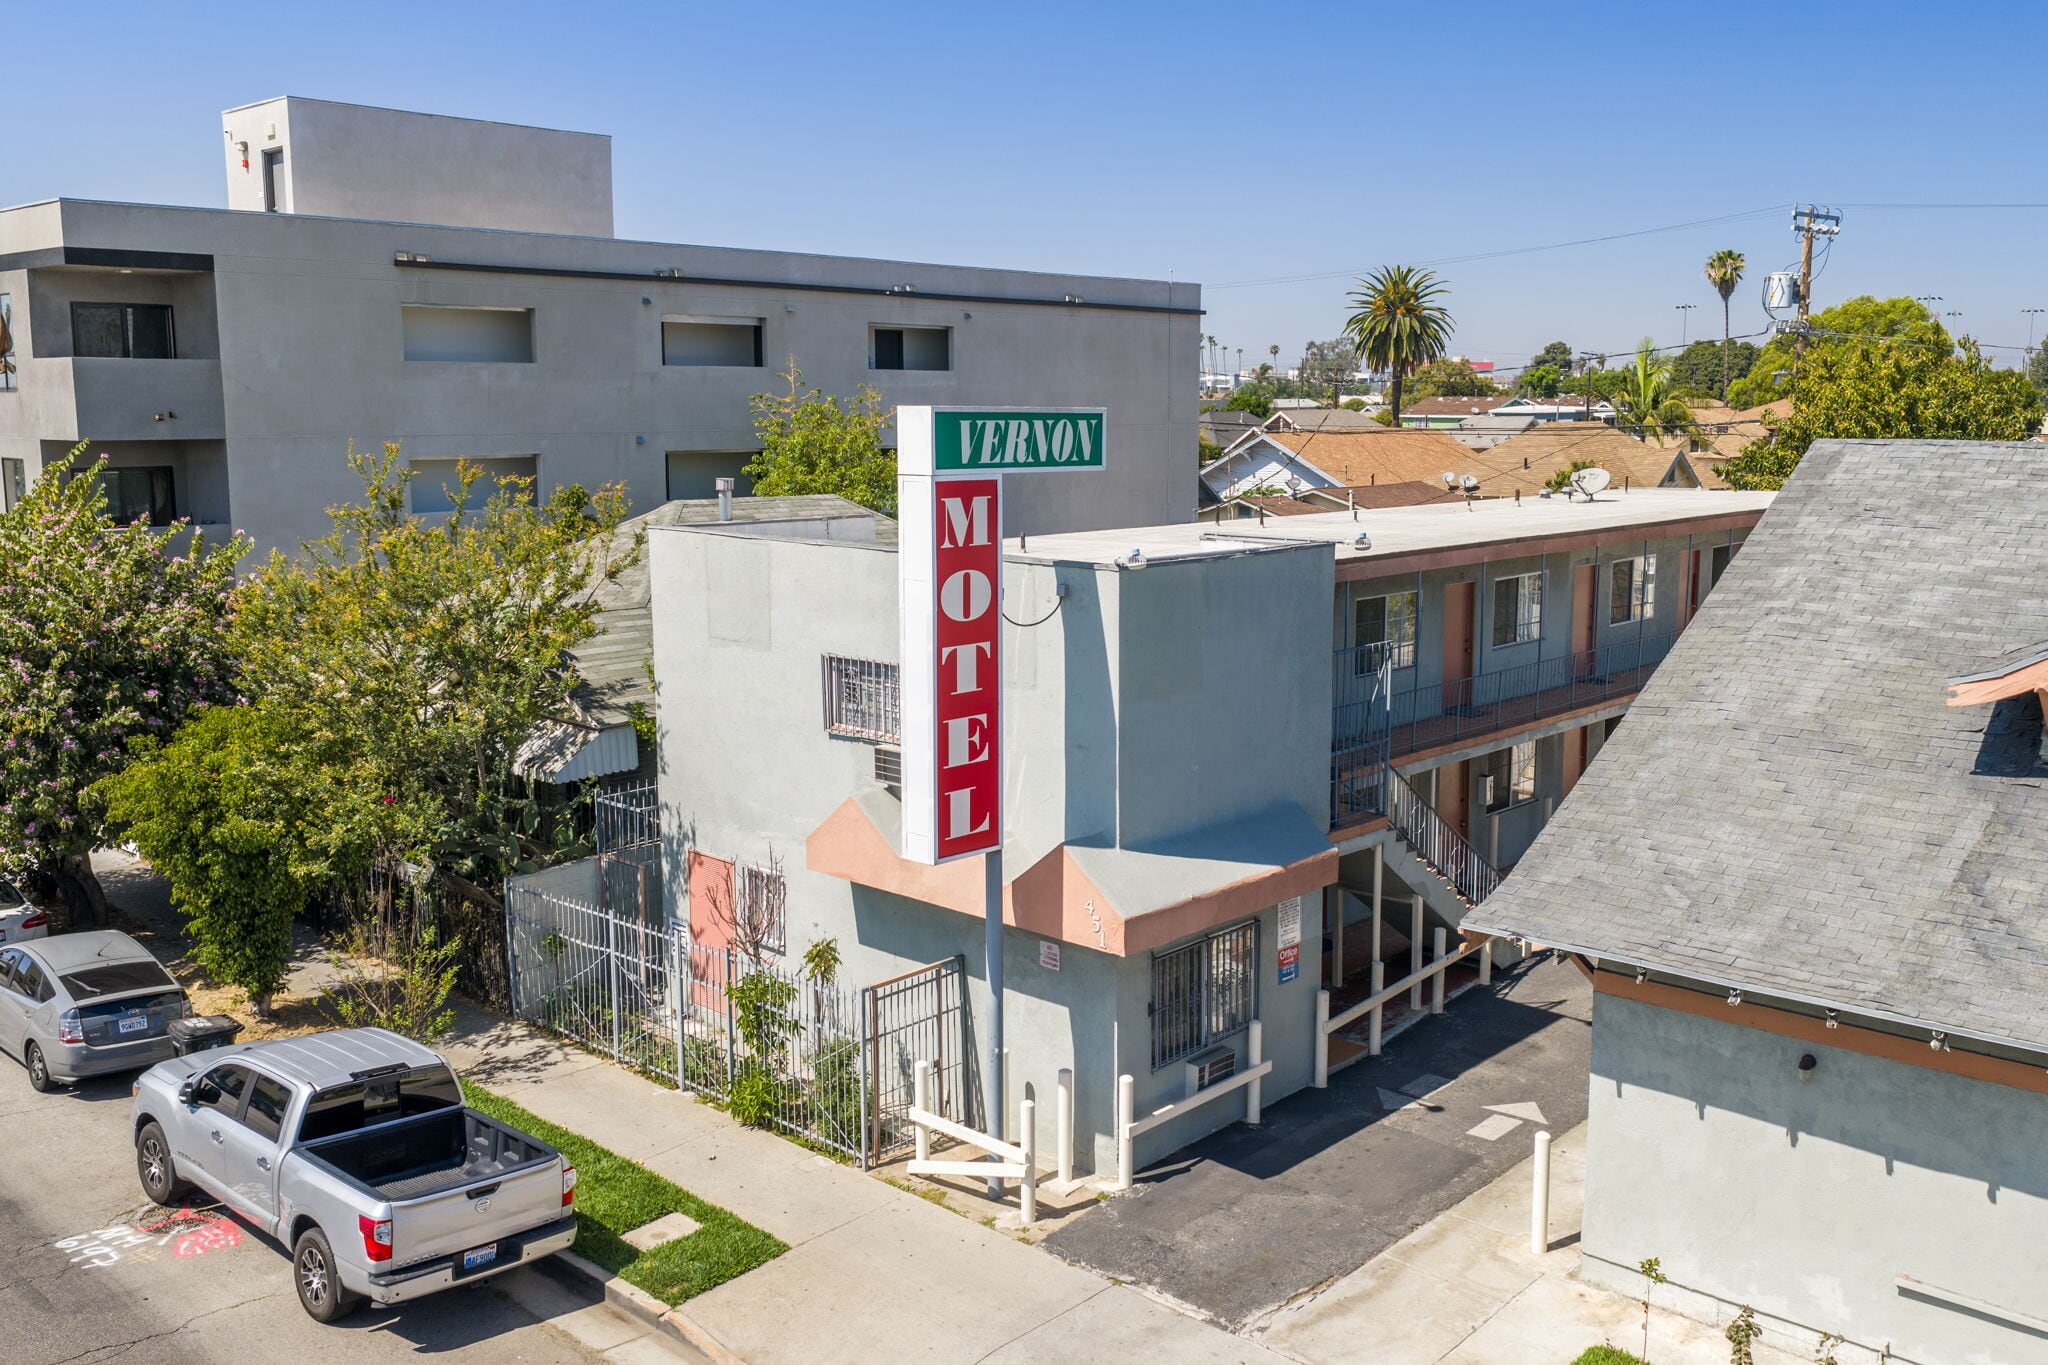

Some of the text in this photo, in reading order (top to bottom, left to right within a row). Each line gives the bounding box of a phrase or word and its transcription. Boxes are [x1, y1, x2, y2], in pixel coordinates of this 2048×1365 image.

[960, 418, 1098, 464] VERNON
[940, 494, 992, 841] MOTEL
[1085, 899, 1106, 949] 451
[1279, 946, 1298, 960] Office
